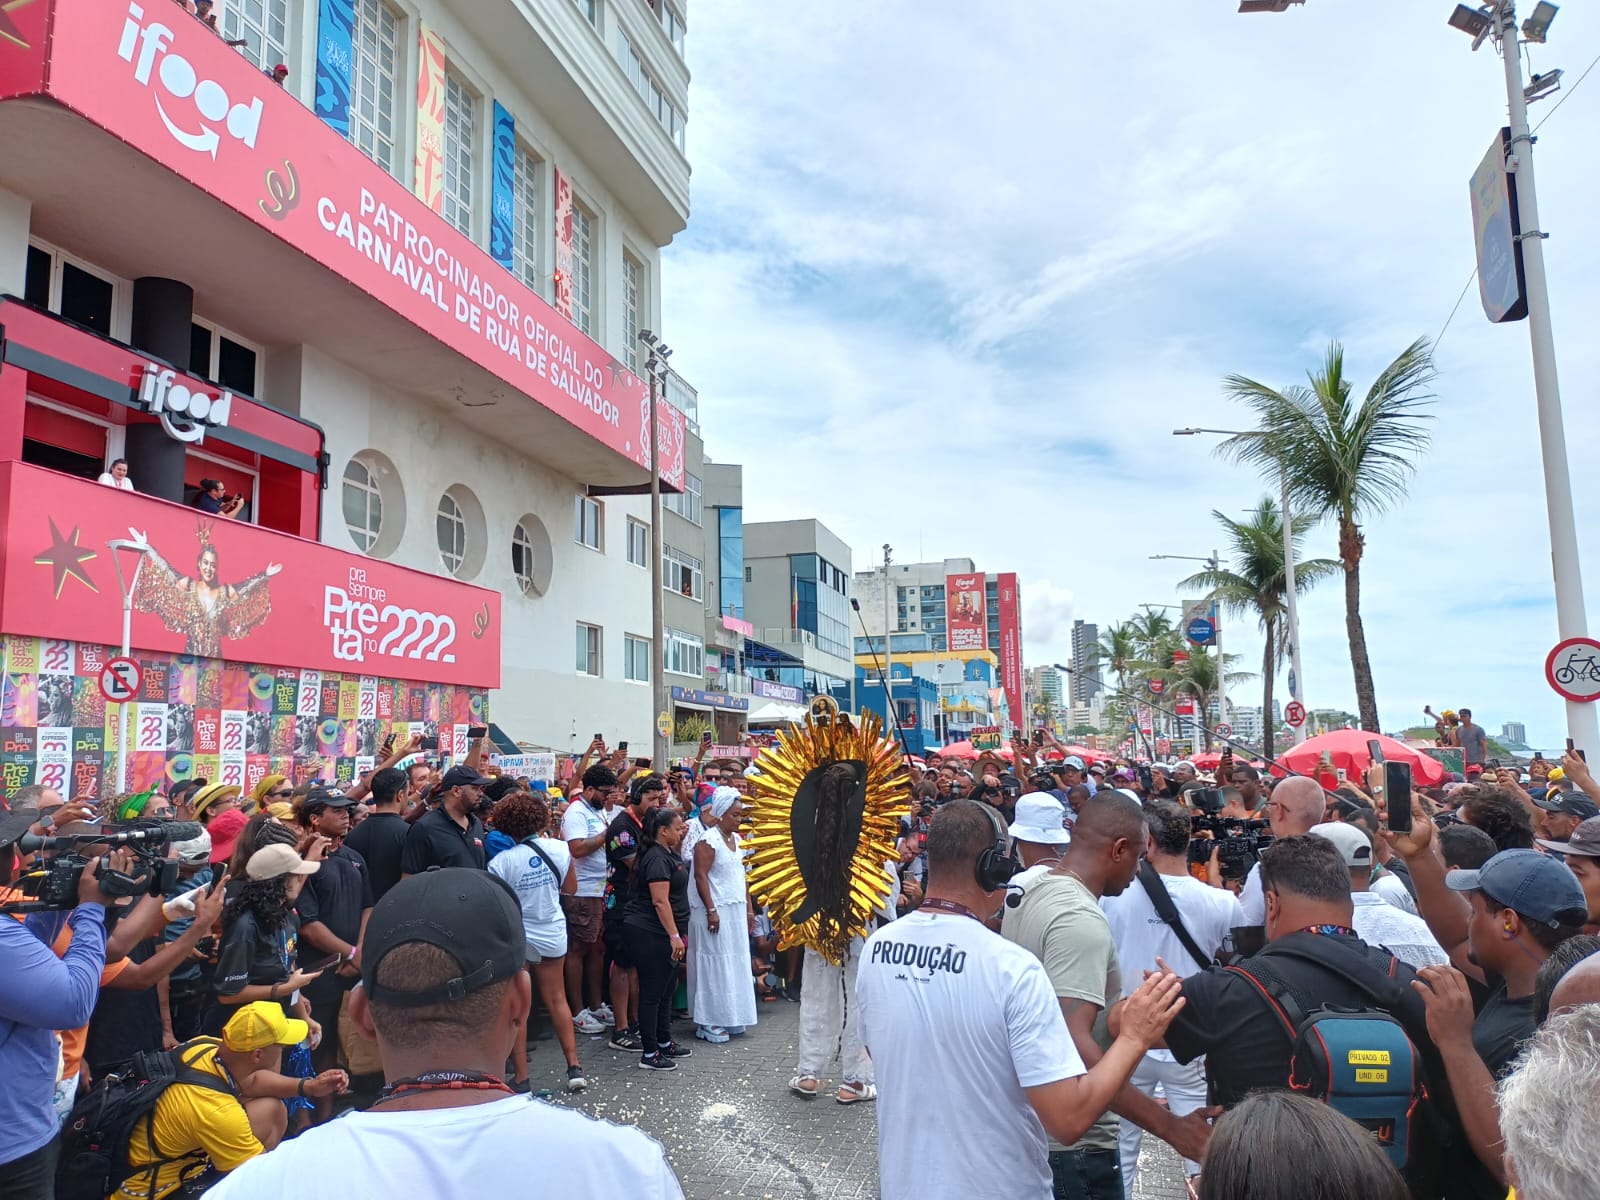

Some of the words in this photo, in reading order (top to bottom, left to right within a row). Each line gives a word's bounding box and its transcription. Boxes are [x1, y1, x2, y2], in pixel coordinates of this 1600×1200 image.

[360, 187, 519, 330] PATROCINADOR
[524, 315, 580, 376] OFICIAL
[584, 360, 603, 390] DO
[318, 196, 449, 312] CARNAVAL
[455, 293, 481, 334] DE
[486, 315, 522, 362] RUA
[526, 344, 547, 379] DE
[550, 361, 620, 428] SALVADOR
[350, 568, 366, 582] pra
[350, 582, 386, 602] sempre
[324, 585, 378, 634] Pre
[330, 618, 364, 662] ta
[364, 638, 378, 652] no
[972, 735, 980, 748] 3
[990, 733, 1000, 747] 10
[872, 940, 966, 976] PRODUÇÃO
